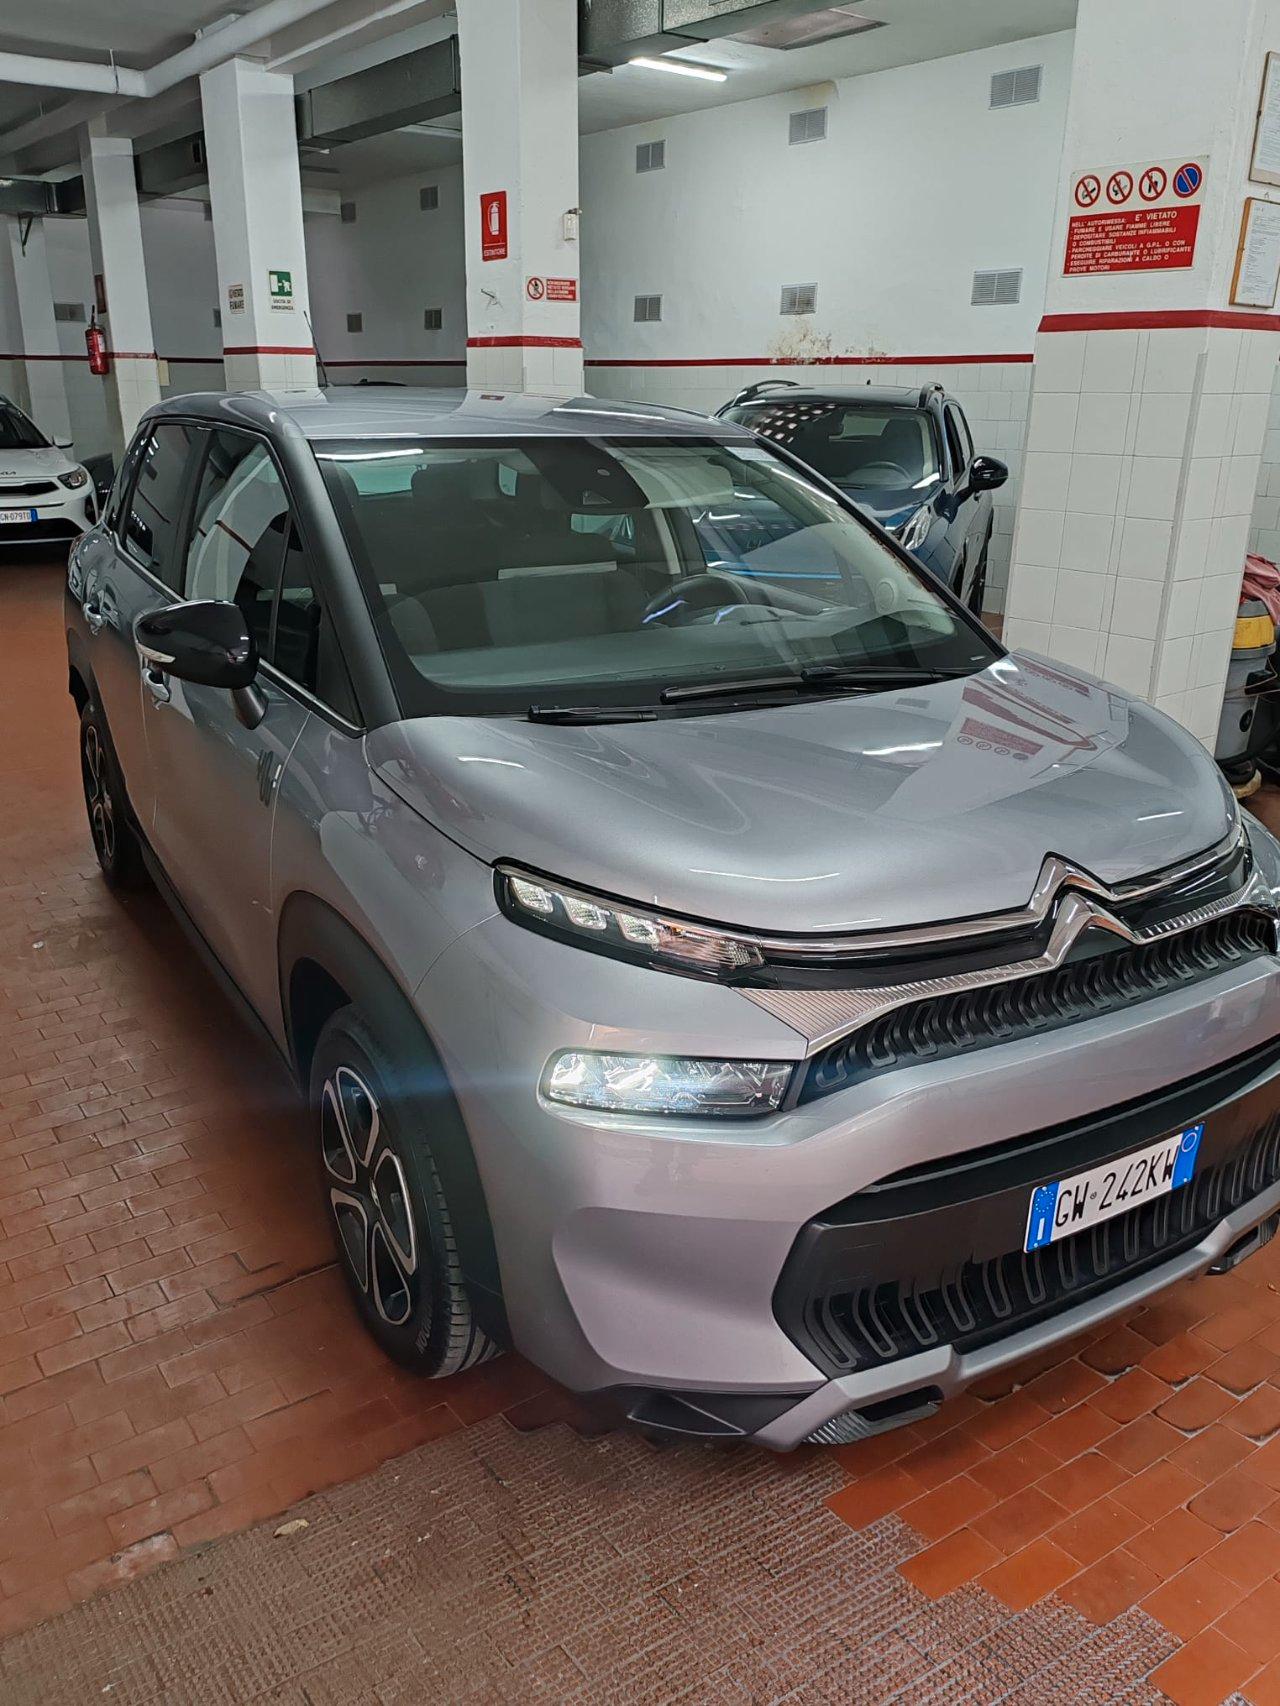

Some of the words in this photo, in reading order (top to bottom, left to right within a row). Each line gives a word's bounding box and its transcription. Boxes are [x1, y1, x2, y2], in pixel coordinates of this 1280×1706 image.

[1146, 211, 1178, 220] VIETATO
[1074, 226, 1097, 234] FUMARE
[1104, 224, 1124, 232] USARE
[1150, 220, 1171, 228] LIBERE
[1073, 232, 1106, 240] DEPOSITARE
[1109, 230, 1137, 238] SOSTANZE
[1138, 227, 1177, 235] INFIAMMABILI
[1079, 238, 1116, 246] COMBUSTIBILI
[1072, 245, 1112, 253] PARCHEGGIARE
[1103, 249, 1141, 258] CARBURANTE
[1150, 246, 1192, 254] LUBRIFICANTE
[1099, 256, 1133, 264] RIPARAZIONI
